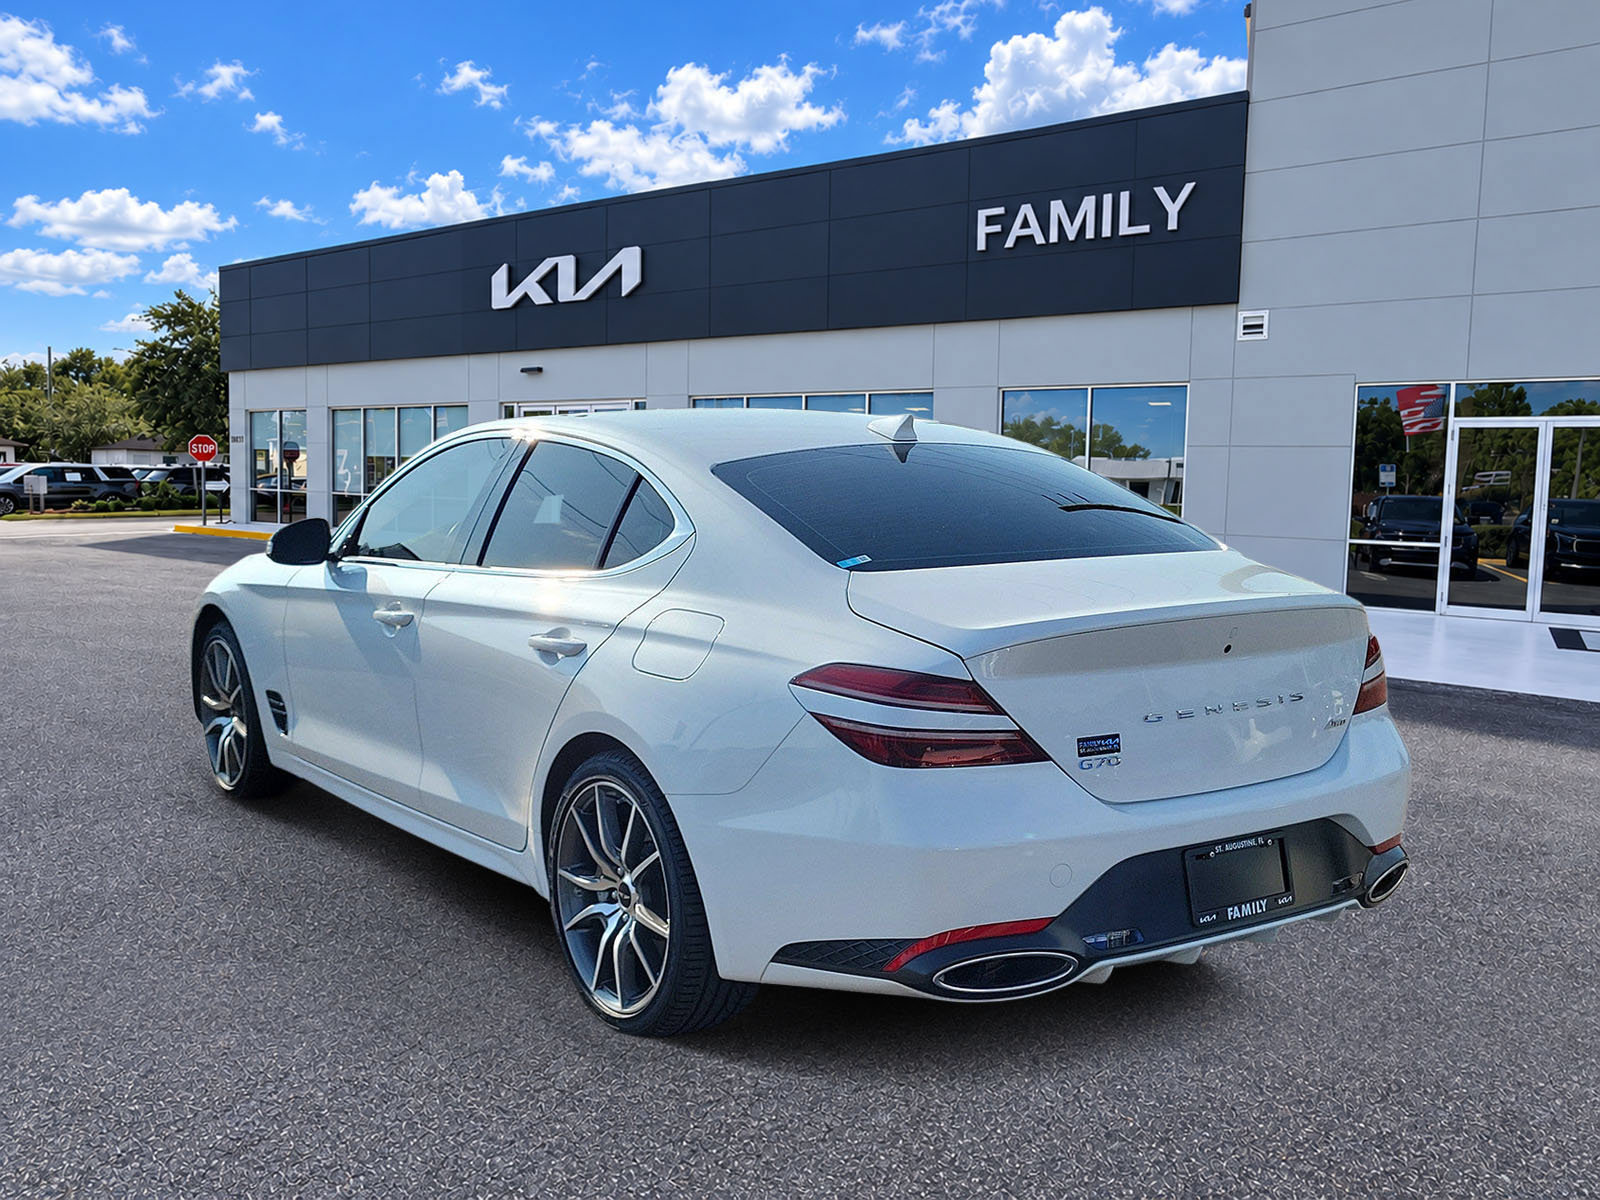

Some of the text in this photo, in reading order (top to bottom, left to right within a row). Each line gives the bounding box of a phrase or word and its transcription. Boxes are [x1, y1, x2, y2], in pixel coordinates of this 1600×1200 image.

[976, 181, 1197, 253] FAMILY
[490, 245, 643, 310] KIA
[191, 443, 215, 454] STOP
[1142, 691, 1305, 723] GENESIS
[1079, 755, 1122, 770] G70
[1214, 837, 1265, 854] ST. AUGUSTINE, FL
[1199, 895, 1293, 924] KIA FAMILY KIA
